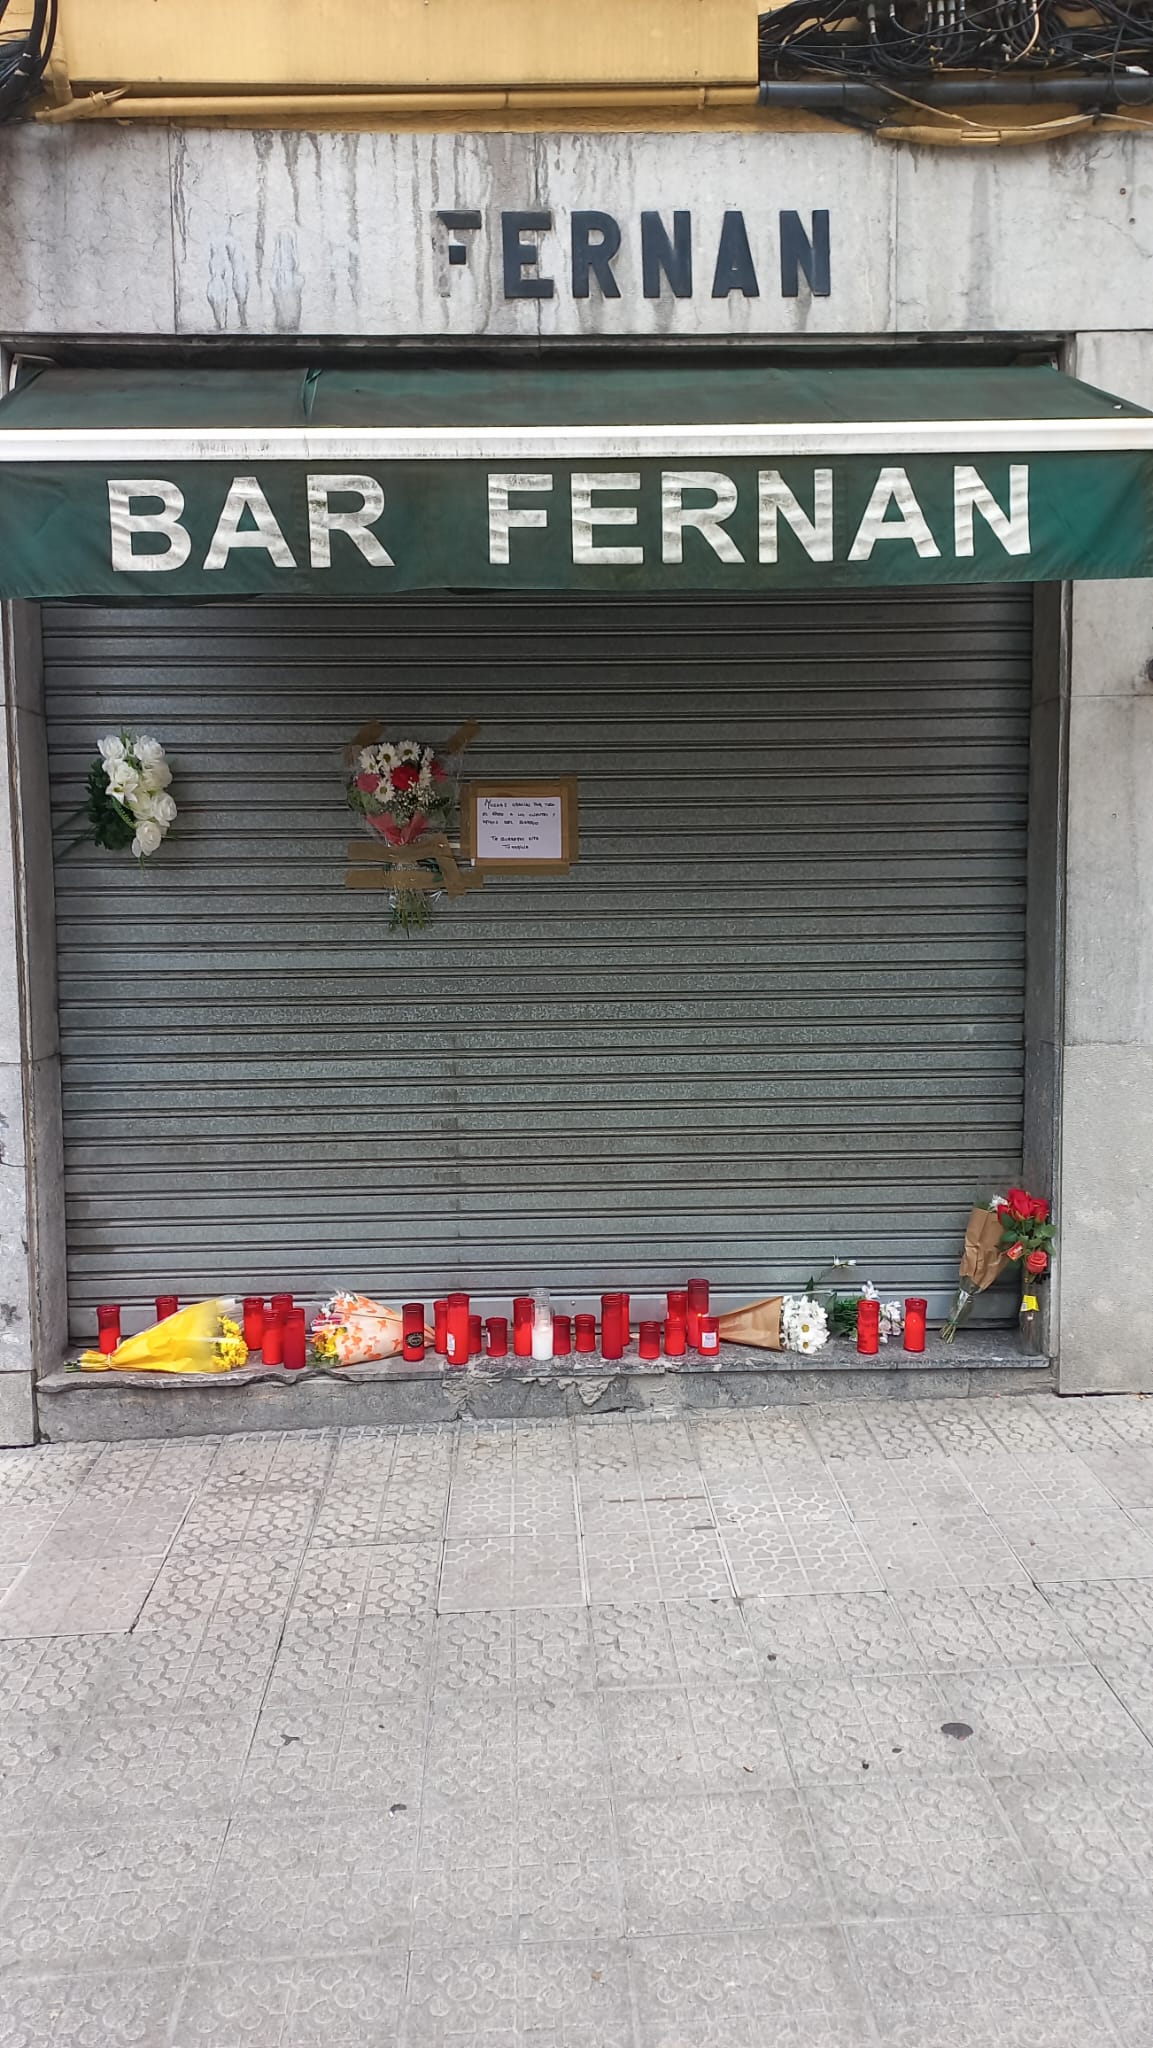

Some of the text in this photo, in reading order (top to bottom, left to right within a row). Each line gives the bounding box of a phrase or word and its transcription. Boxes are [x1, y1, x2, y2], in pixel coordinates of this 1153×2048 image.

[437, 209, 831, 299] FERNAN
[107, 465, 1031, 572] BAR FERNAN
